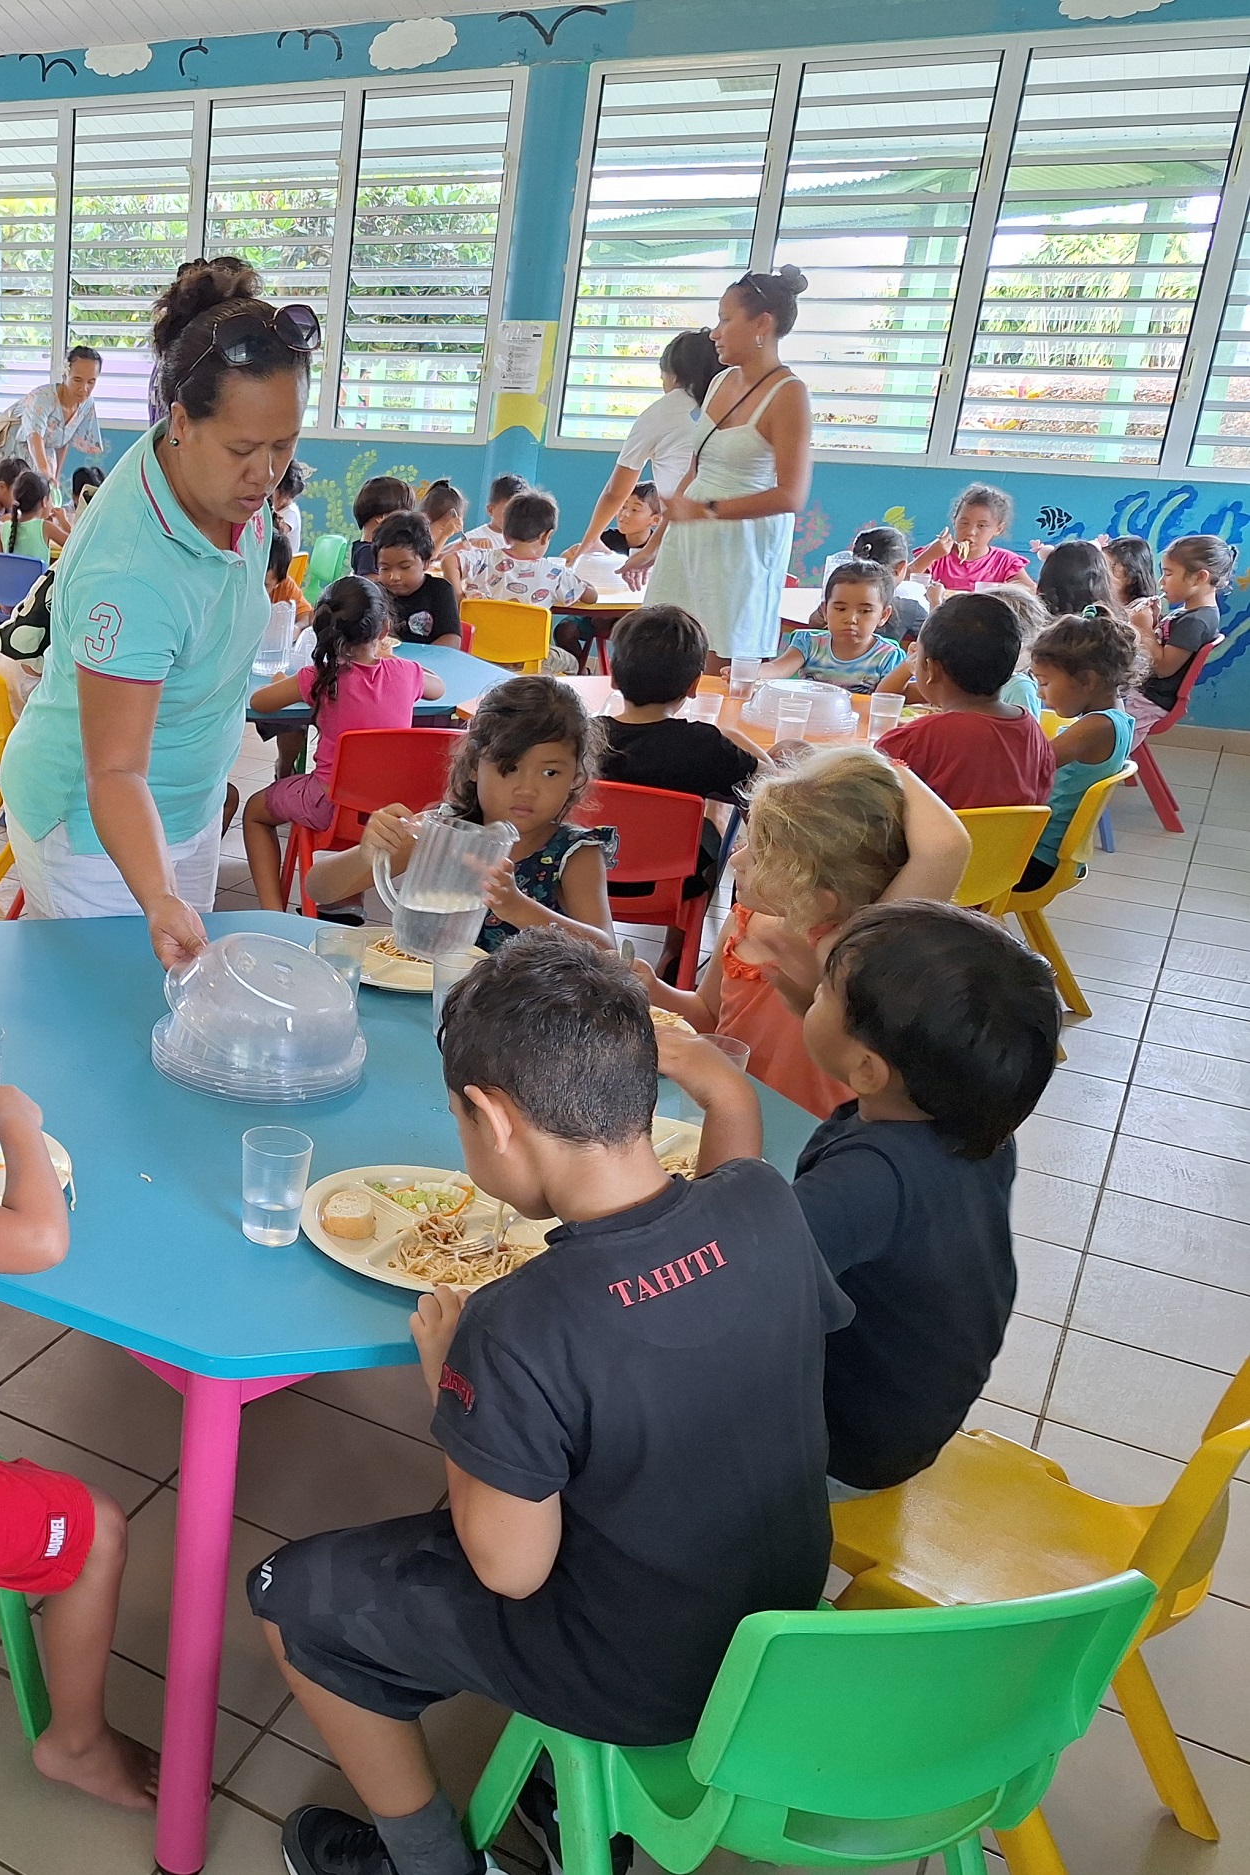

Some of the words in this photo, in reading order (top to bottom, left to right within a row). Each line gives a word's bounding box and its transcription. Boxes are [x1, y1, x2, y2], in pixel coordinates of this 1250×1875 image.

[84, 602, 122, 664] 3
[608, 1240, 728, 1307] TAHITI
[44, 1517, 65, 1557] MARVEL
